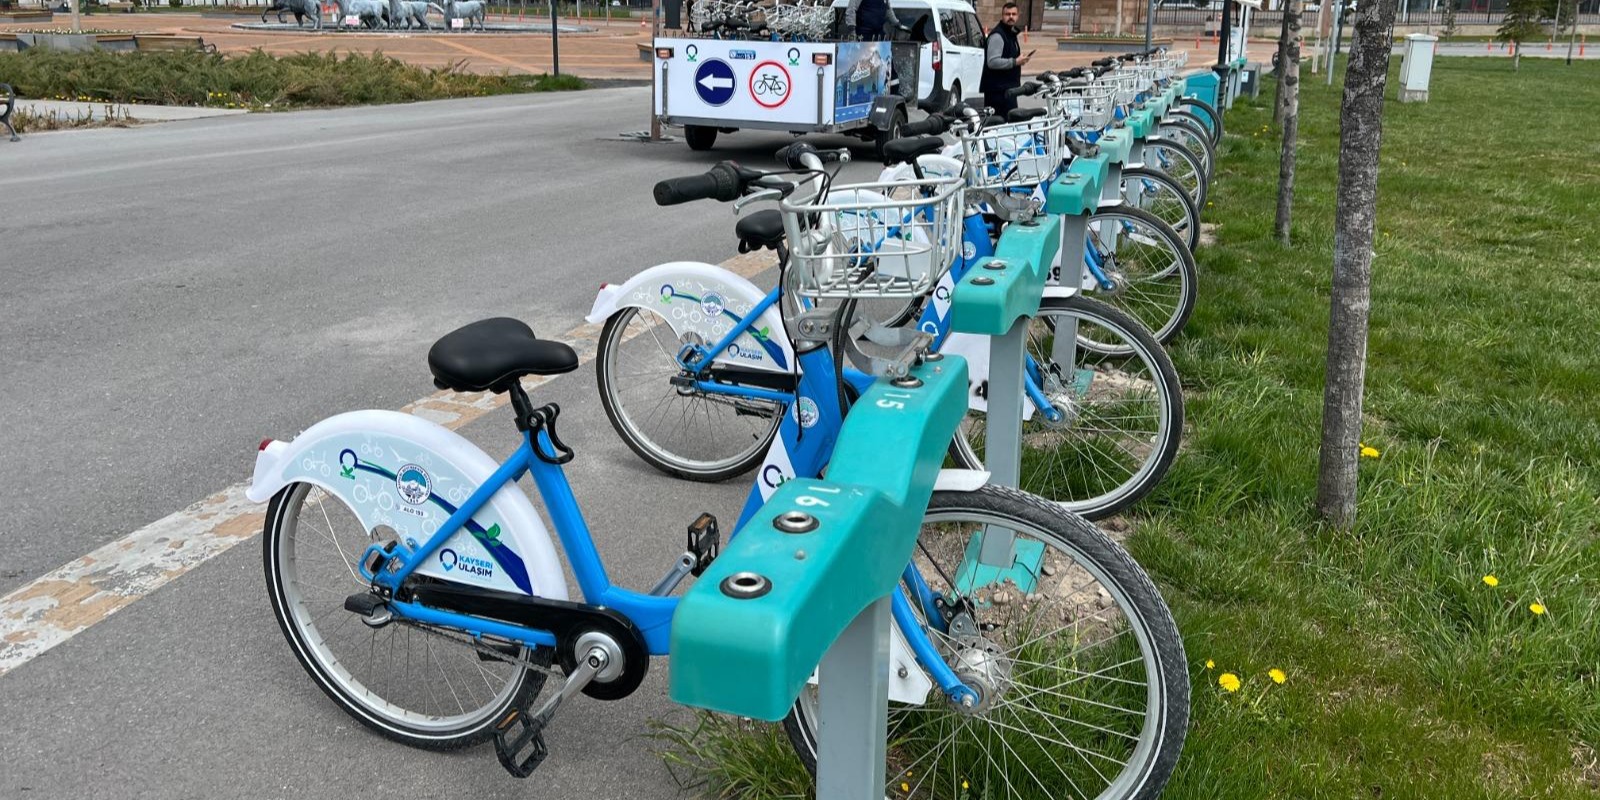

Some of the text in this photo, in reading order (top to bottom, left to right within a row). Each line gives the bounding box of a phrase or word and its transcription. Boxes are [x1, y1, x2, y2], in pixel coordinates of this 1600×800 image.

[876, 393, 911, 409] 15
[794, 486, 841, 507] 16
[458, 562, 493, 577] ULAŞIM
